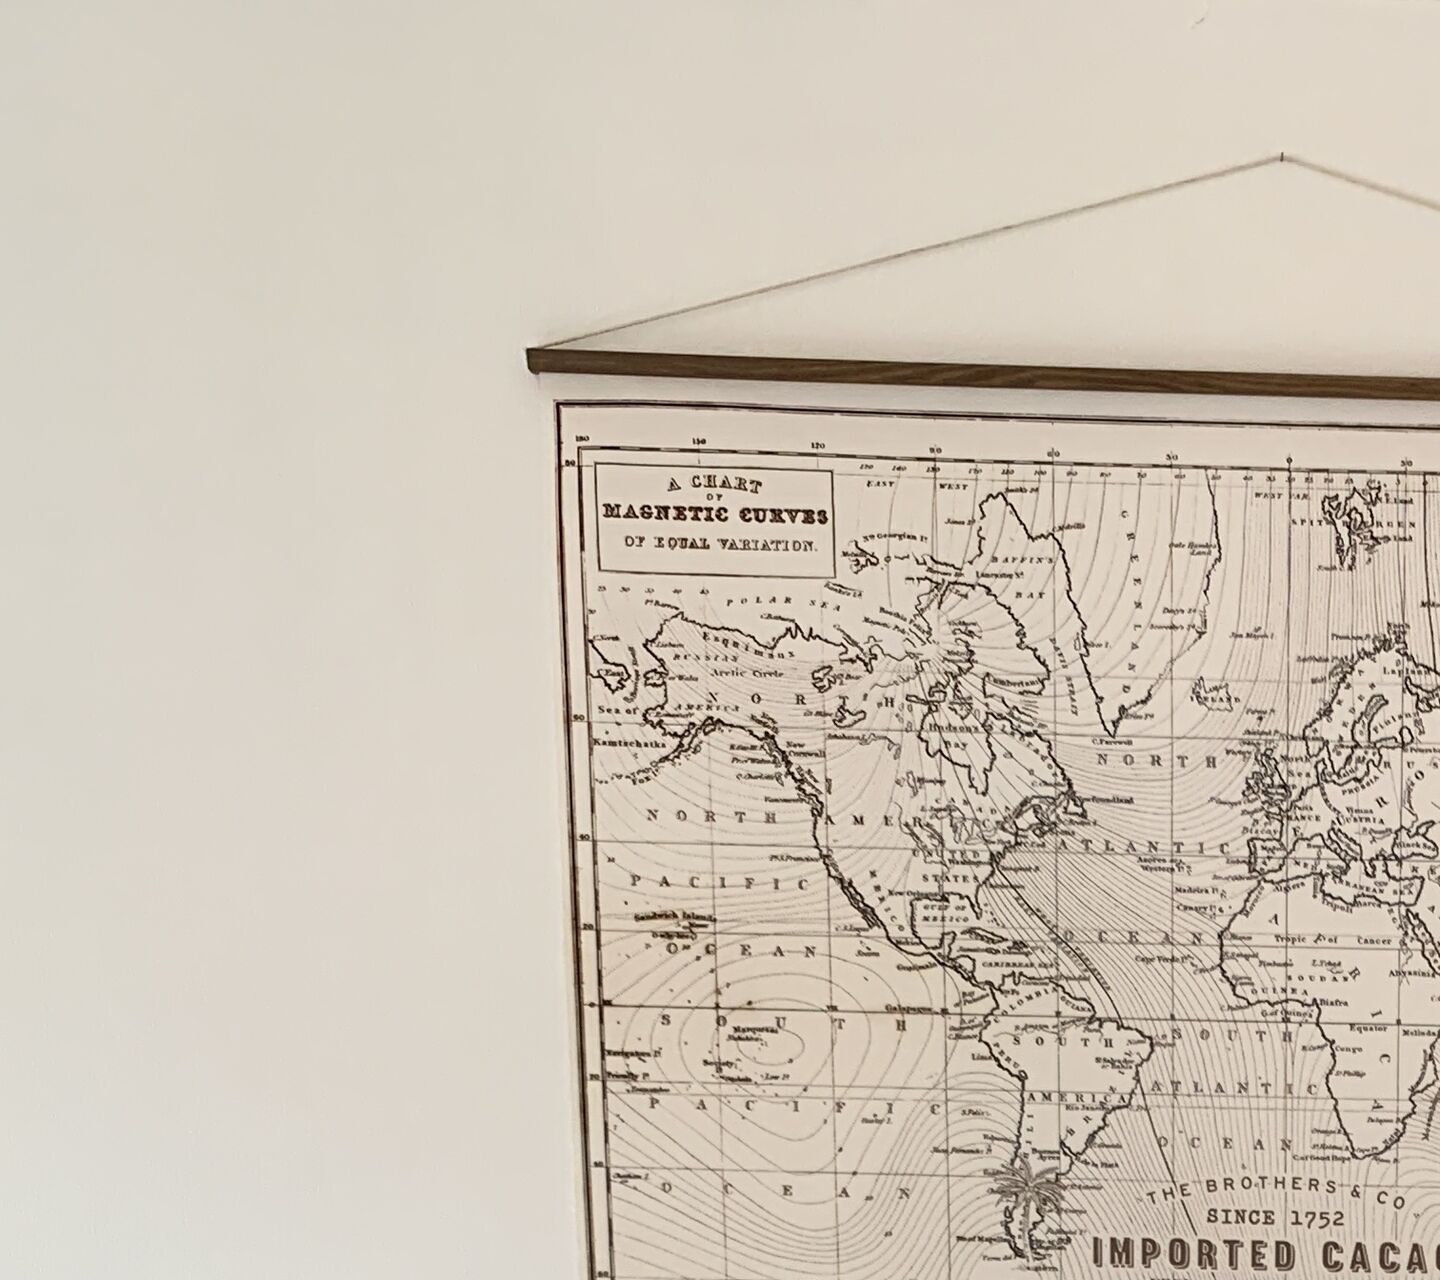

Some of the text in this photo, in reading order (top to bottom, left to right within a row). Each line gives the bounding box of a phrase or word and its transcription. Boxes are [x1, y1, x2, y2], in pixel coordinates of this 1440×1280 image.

[667, 474, 763, 494] A CHART
[939, 483, 968, 491] WEST
[706, 493, 724, 501] OF
[601, 503, 829, 525] MAGNETIC CURVES
[624, 535, 819, 553] OF EQUAL VARIATION.
[1097, 753, 1217, 769] NORTH
[646, 808, 778, 825] NORTH
[1059, 839, 1231, 855] ATLANTIC
[630, 874, 810, 890] PACIFIC
[1064, 930, 1202, 944] OCEAN
[665, 941, 817, 956] OCEAN
[660, 1013, 907, 1033] SOUTH
[1028, 1092, 1127, 1104] AMERICA
[649, 1097, 942, 1117] PACIFIC
[1146, 1176, 1405, 1210] THE BROTHERS & CO
[1206, 1208, 1344, 1229] SINCE 1752
[1092, 1235, 1296, 1273] IMPORTED
